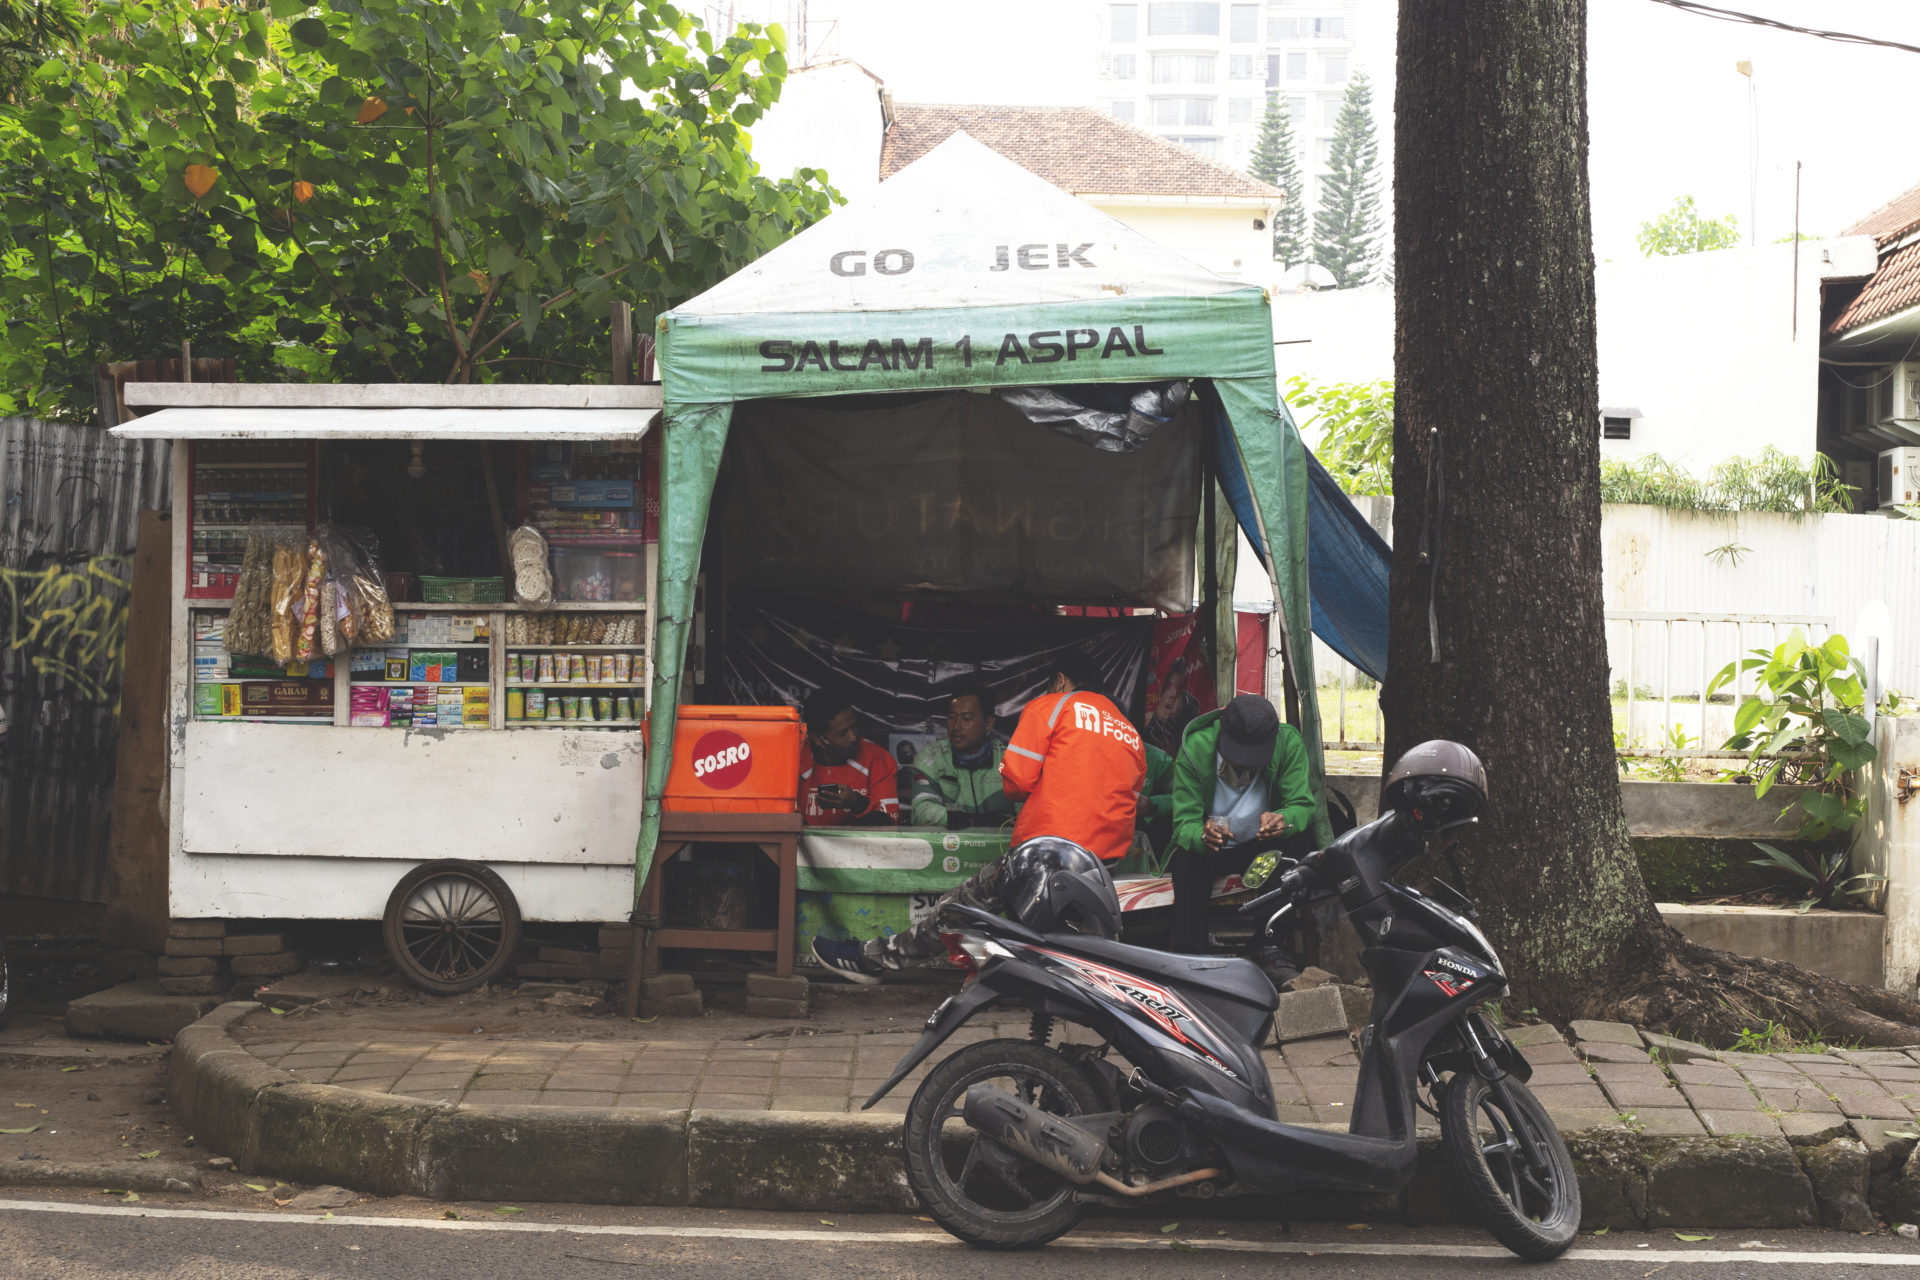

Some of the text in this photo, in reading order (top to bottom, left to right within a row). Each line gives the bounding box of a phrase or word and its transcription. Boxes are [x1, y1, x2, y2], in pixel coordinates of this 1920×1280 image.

[829, 243, 1098, 277] GO JEK
[760, 325, 1165, 373] SALAM 1 ASPAL
[274, 687, 309, 696] GARAM
[1103, 721, 1139, 751] Food
[694, 742, 751, 778] SOSRO
[1437, 957, 1478, 979] HONDA
